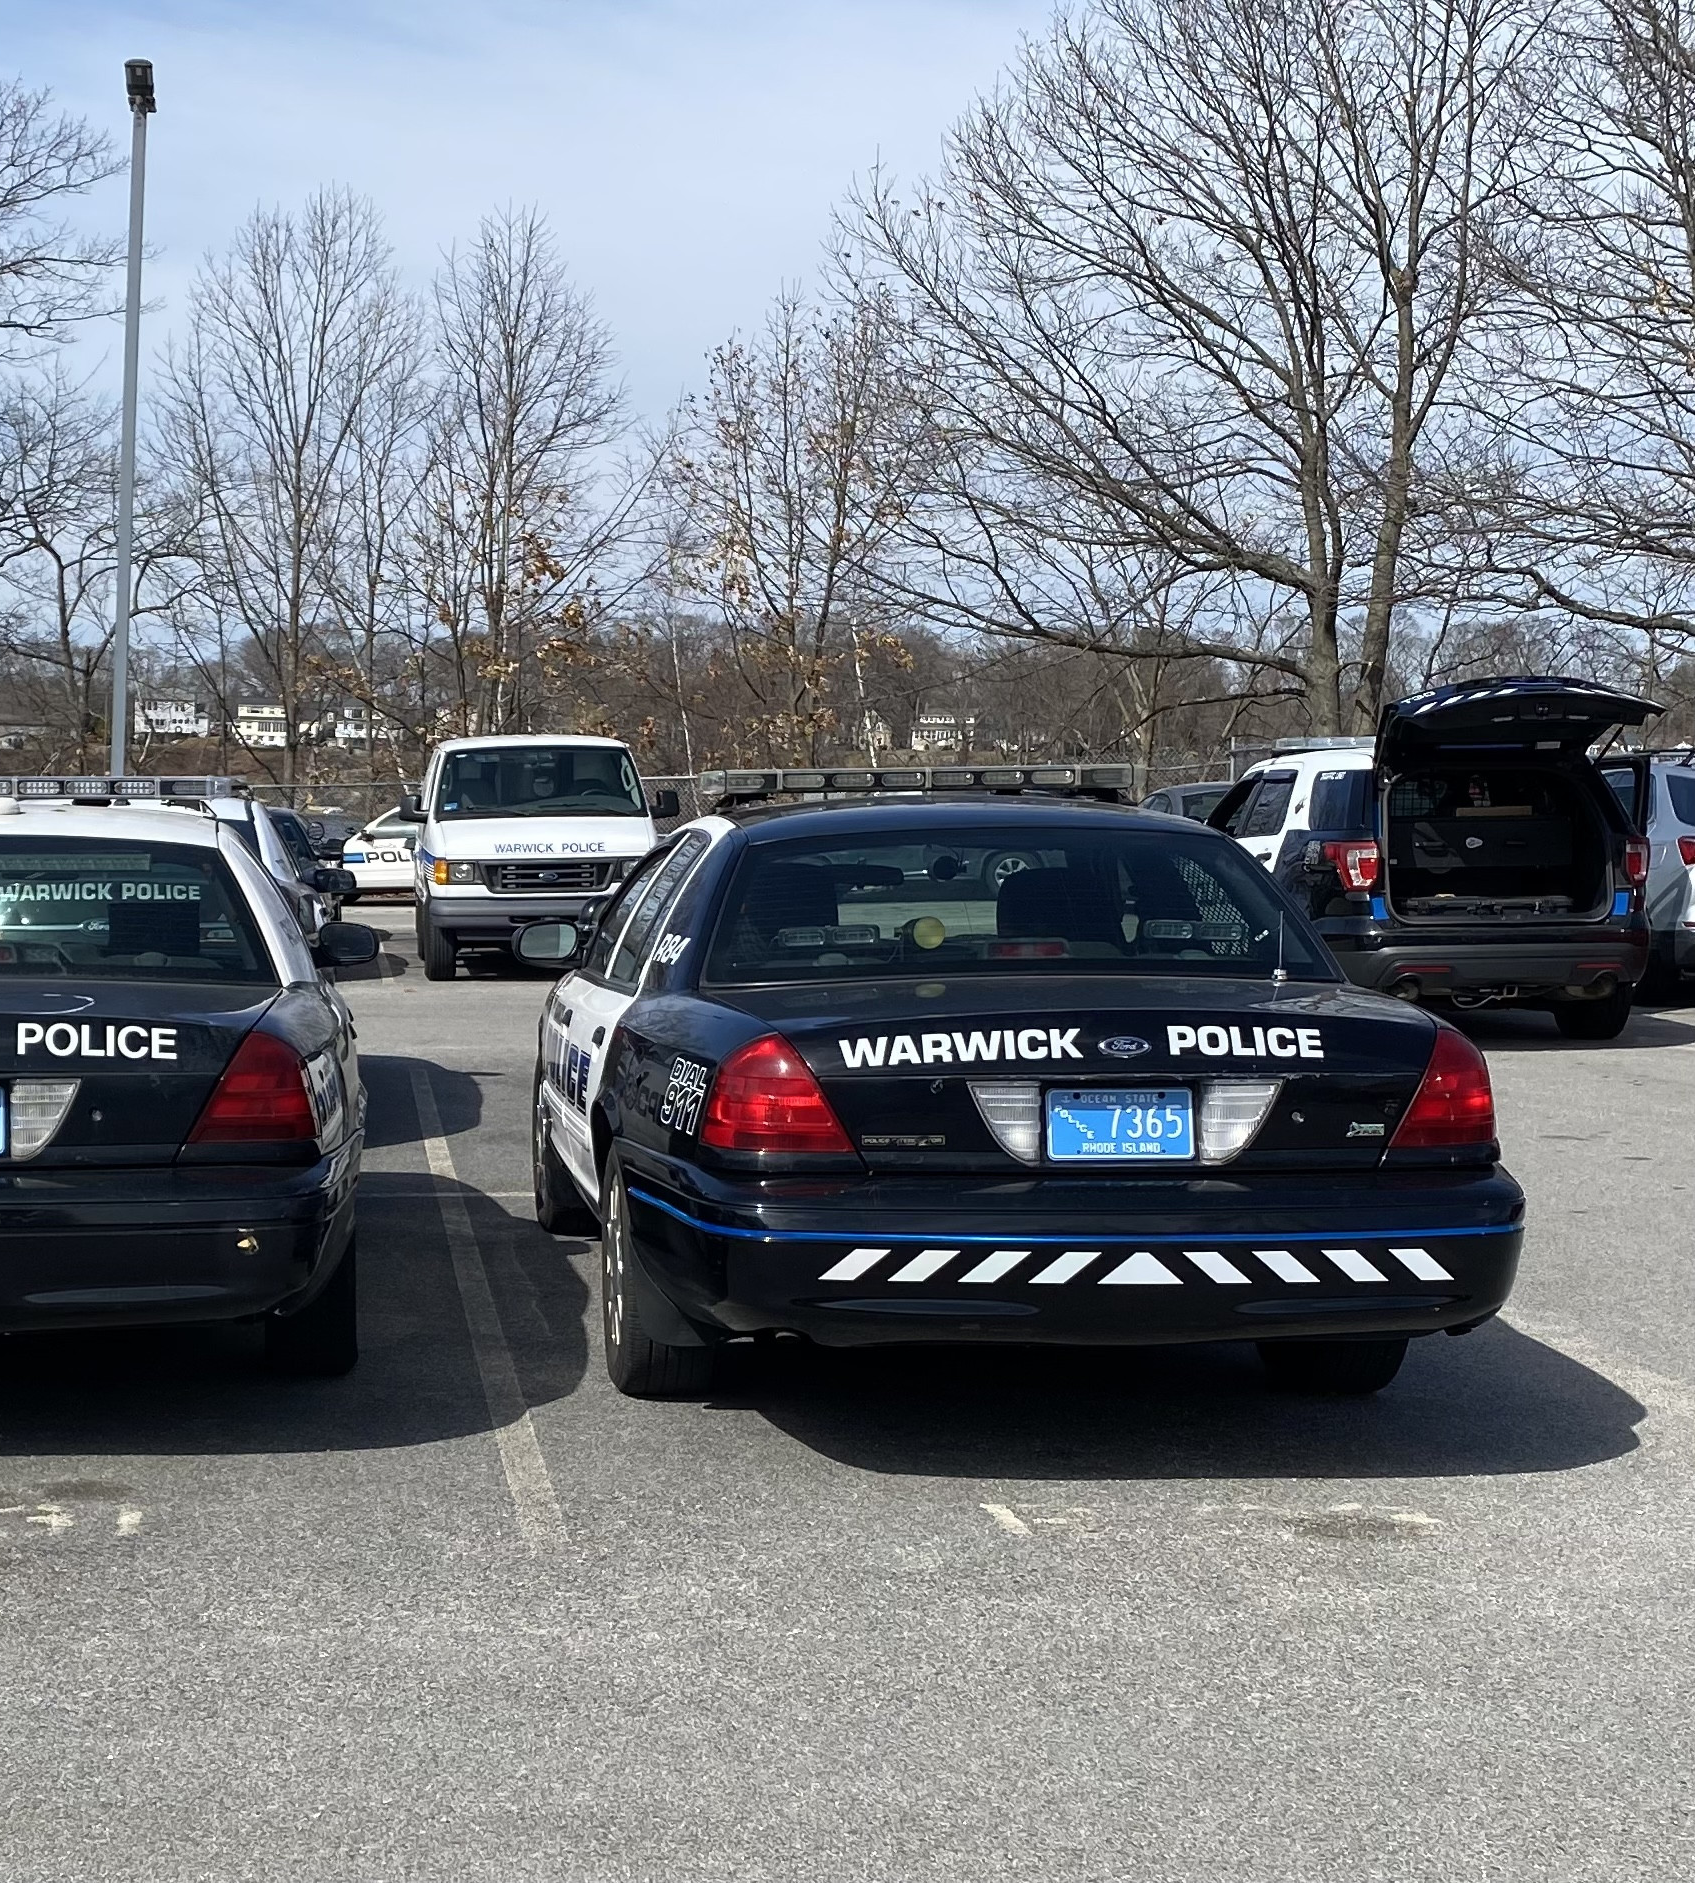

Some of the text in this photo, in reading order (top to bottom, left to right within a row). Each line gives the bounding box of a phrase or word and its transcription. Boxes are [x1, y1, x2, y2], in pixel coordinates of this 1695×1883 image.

[494, 842, 605, 853] WARWICK POLICE
[0, 882, 202, 902] WARWICK POLICE
[653, 933, 691, 965] R84
[16, 1022, 178, 1060] POLICE
[838, 1025, 1325, 1068] WARWICK POLICE
[1111, 1038, 1138, 1050] Ford
[669, 1057, 708, 1092] DIAL
[660, 1082, 705, 1136] 911
[1080, 1094, 1160, 1103] OCEAN STATE
[1054, 1104, 1095, 1140] POLICE
[1106, 1104, 1183, 1139] 7365
[1081, 1142, 1161, 1153] RHODE ISLAND
